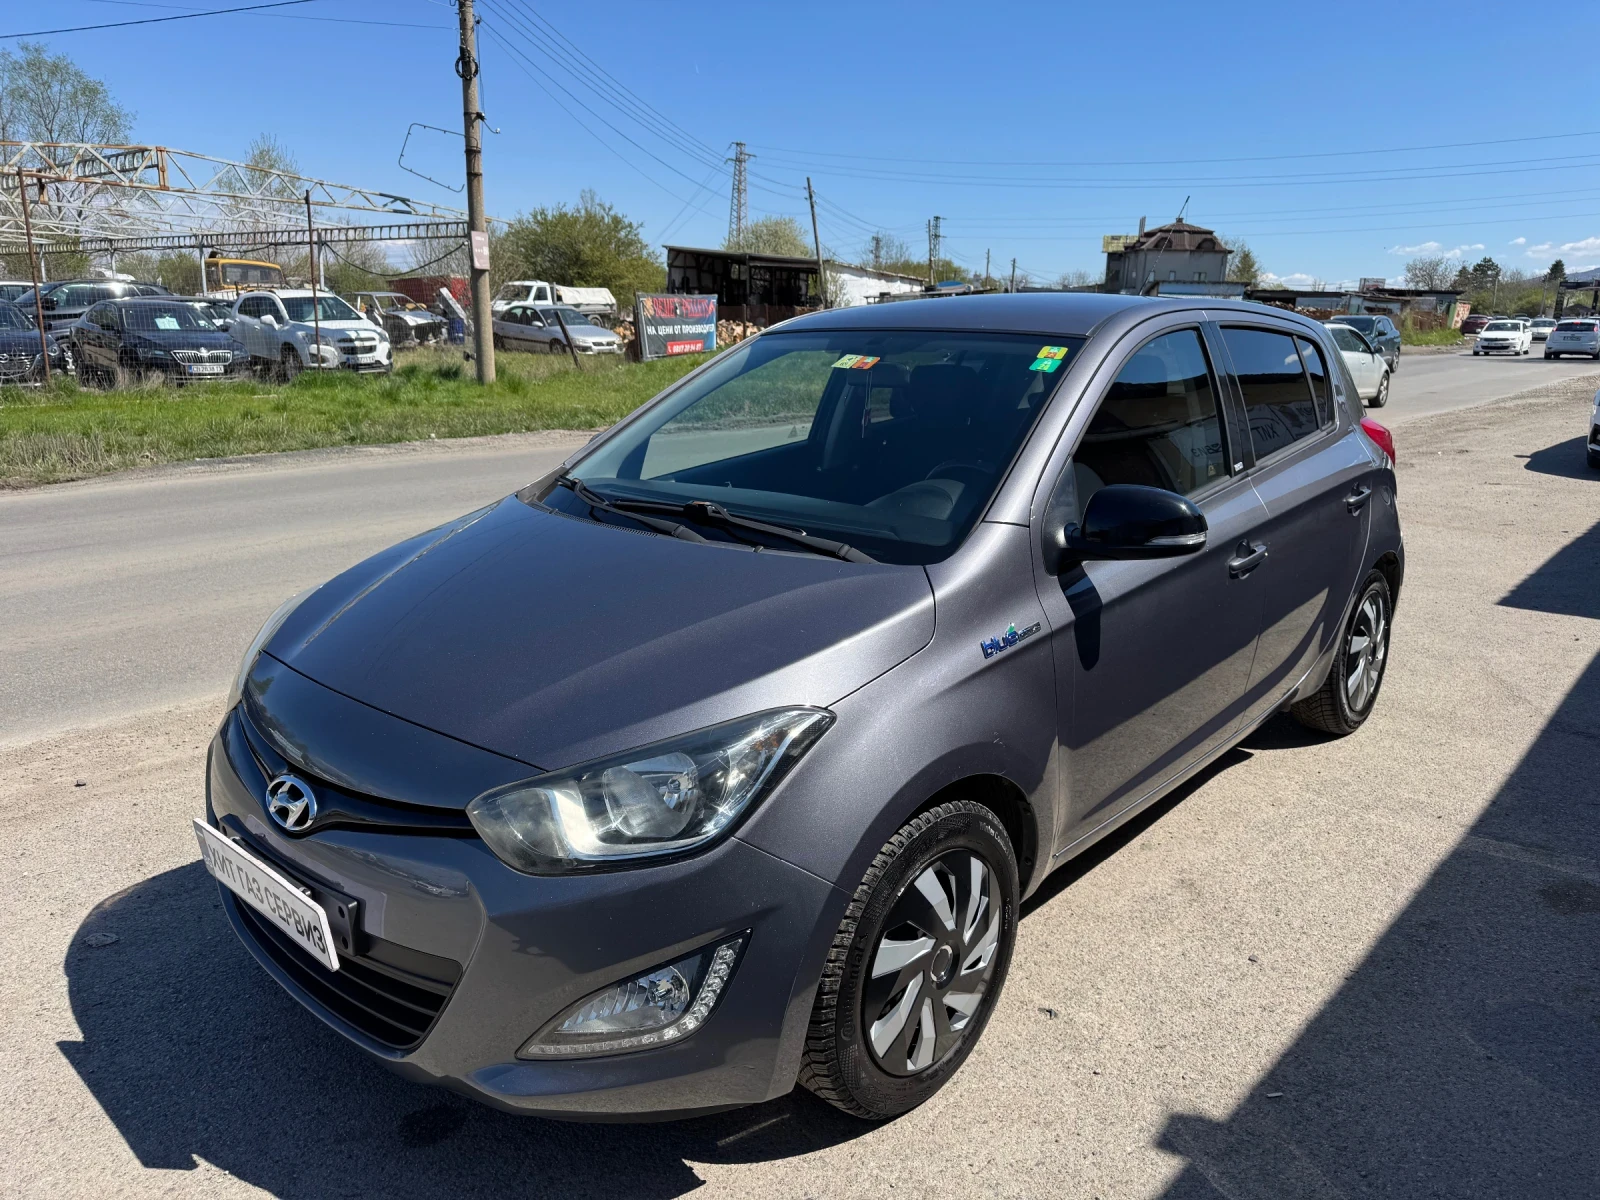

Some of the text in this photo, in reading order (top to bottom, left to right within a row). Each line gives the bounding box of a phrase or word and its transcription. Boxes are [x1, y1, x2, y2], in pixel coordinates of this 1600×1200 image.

[646, 325, 656, 335] НА
[658, 325, 673, 336] ЦЕНИ
[674, 325, 681, 335] ОТ
[980, 628, 1019, 659] blue
[208, 844, 326, 955] ХИТ ГАЗ СЕРВИЗ
